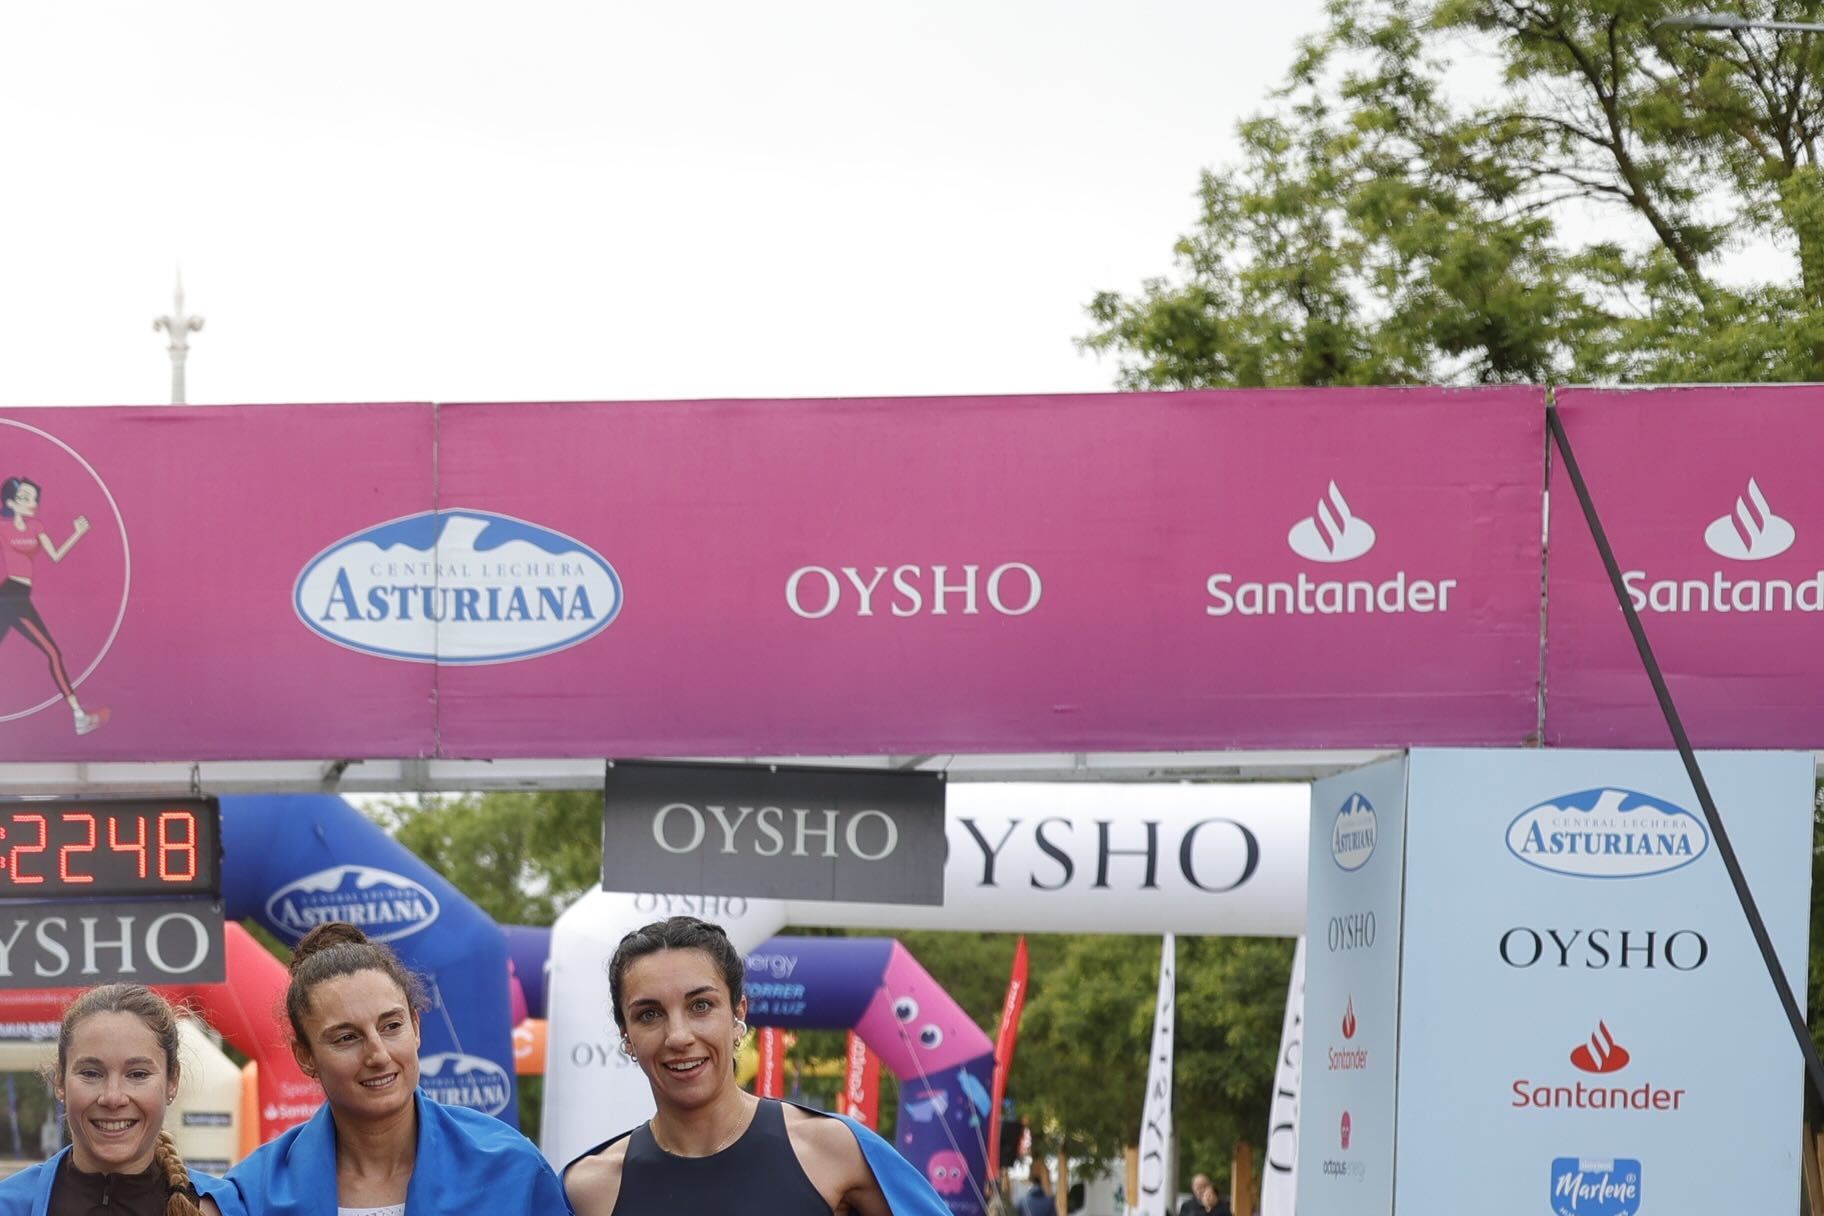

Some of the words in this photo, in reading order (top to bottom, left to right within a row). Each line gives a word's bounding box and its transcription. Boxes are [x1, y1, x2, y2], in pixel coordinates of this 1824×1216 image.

[370, 562, 472, 578] CENTRAL
[481, 562, 586, 578] LECHERA
[784, 561, 1043, 619] OYSHO
[319, 565, 597, 622] ASTURIANA
[1206, 571, 1457, 616] Santander
[1619, 570, 1824, 613] Santand
[651, 802, 900, 861] OYSHO
[1520, 819, 1694, 857] ASTURIANA
[1552, 817, 1616, 829] CENTRAL
[1621, 817, 1688, 829] LECHERA
[945, 816, 1262, 893] YSHO
[280, 898, 428, 927] ASTURIANA
[1328, 911, 1376, 952] OYSHO
[743, 954, 798, 979] nergy
[1498, 926, 1709, 972] OYSHO
[570, 1041, 636, 1069] OYS
[1328, 1046, 1369, 1071] Santander
[1512, 1079, 1686, 1111] Santander
[1555, 1171, 1637, 1211] Marlene
